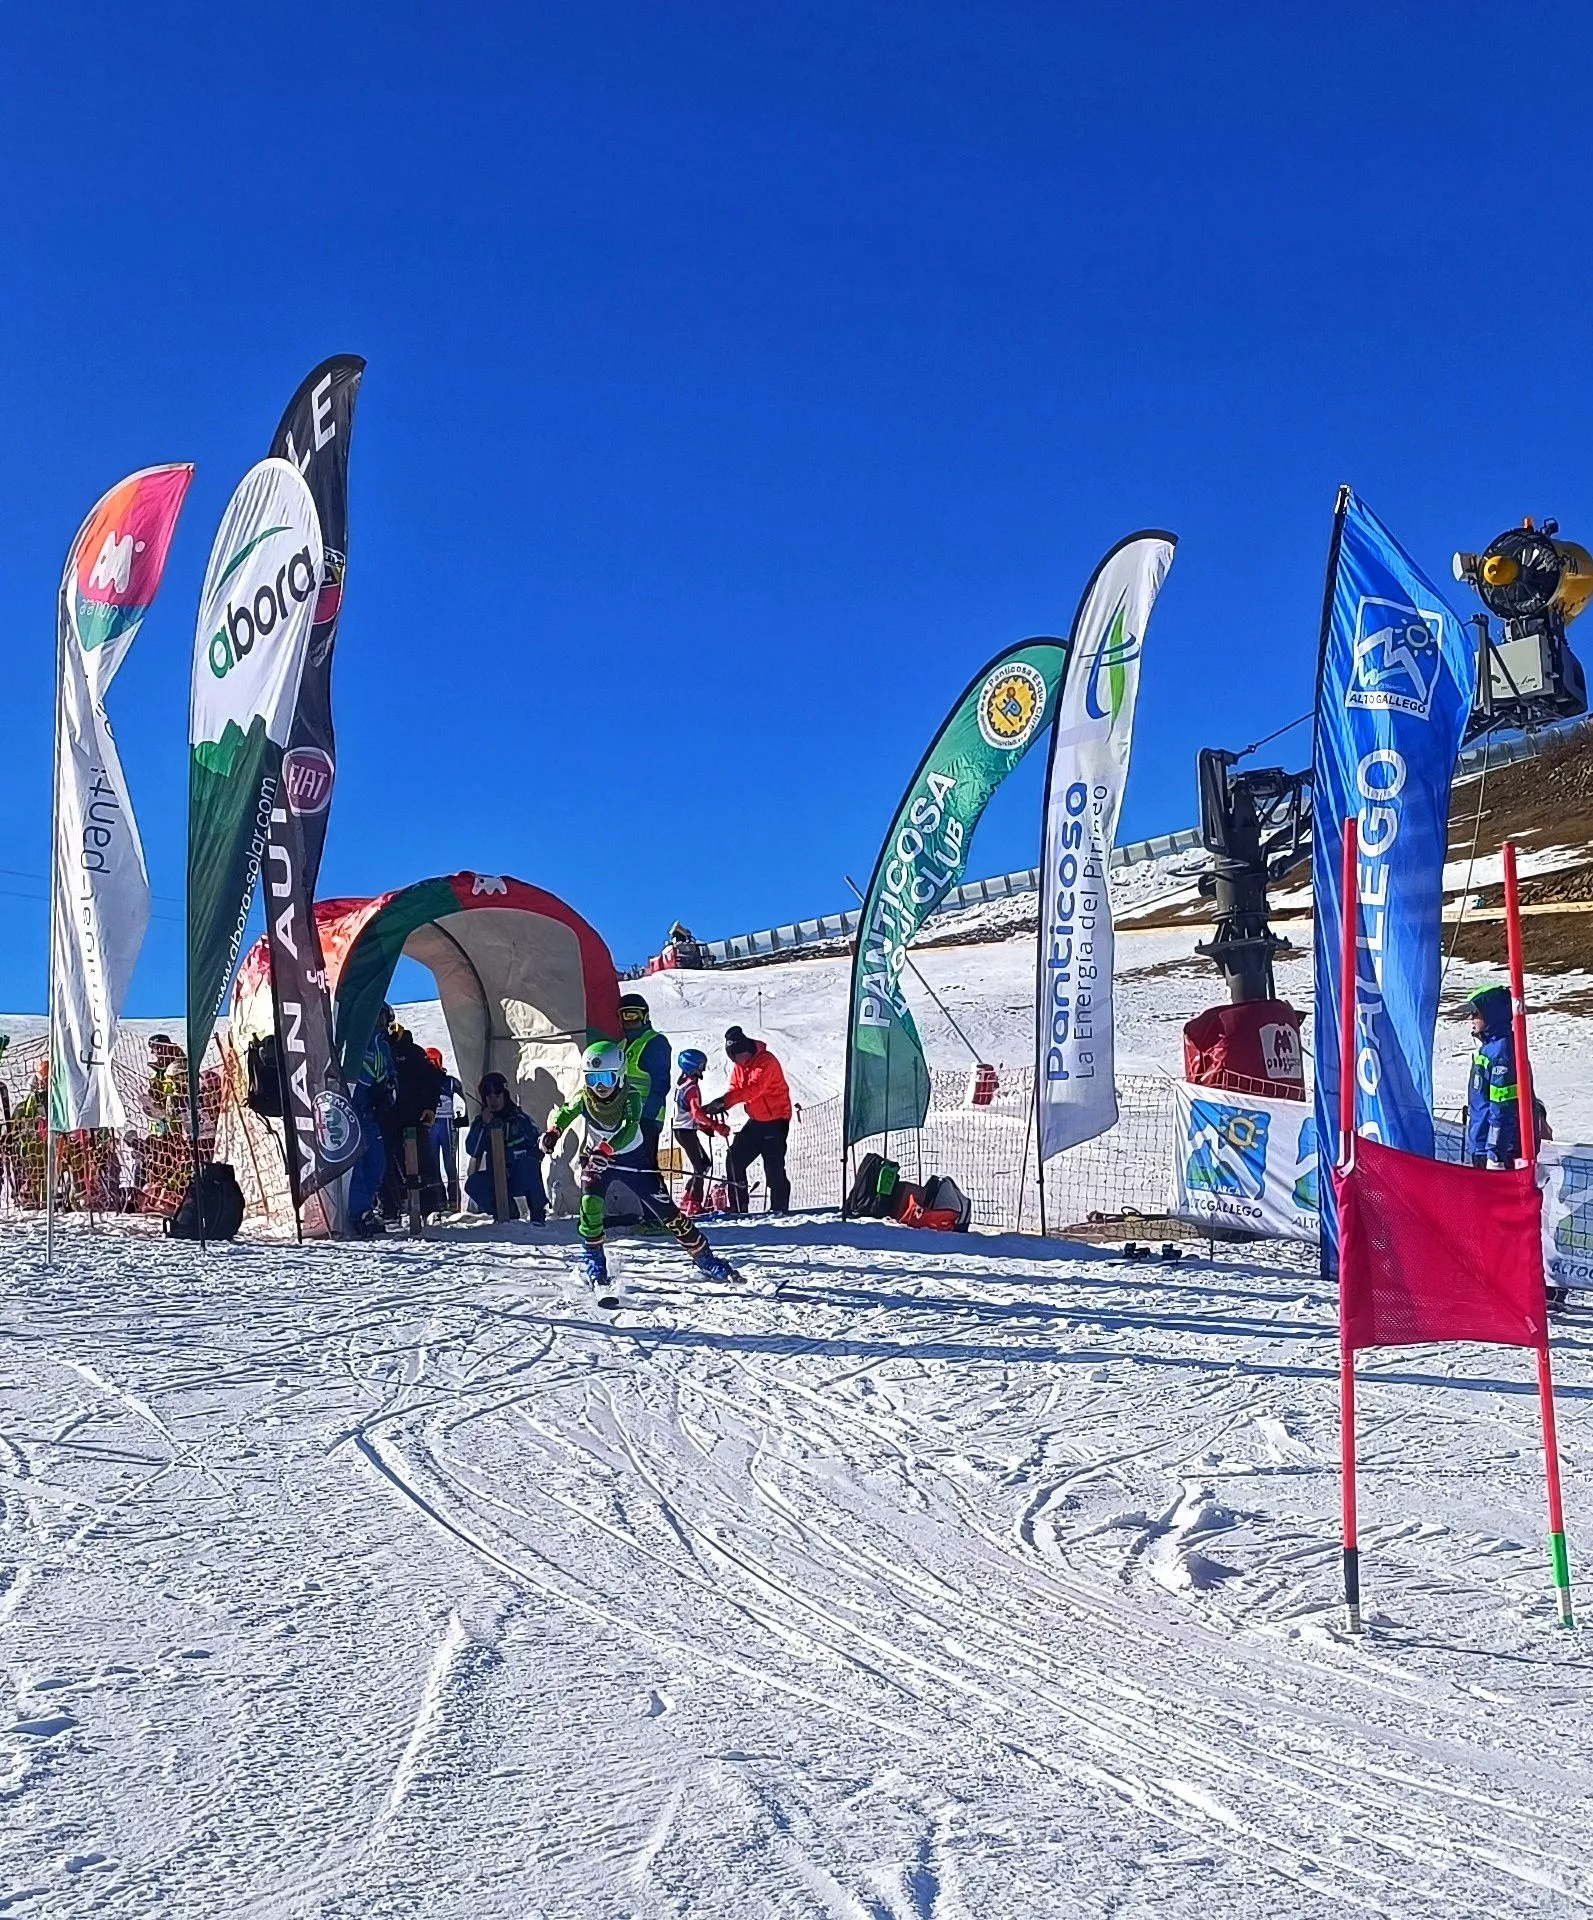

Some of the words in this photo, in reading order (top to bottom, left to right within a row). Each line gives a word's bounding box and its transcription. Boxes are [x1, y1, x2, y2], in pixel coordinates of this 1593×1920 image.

[208, 544, 316, 679] abora
[988, 664, 1033, 688] Panticosa
[287, 762, 329, 802] FIAT
[858, 770, 958, 1028] PANTICOSA
[910, 815, 965, 905] CLUB
[1046, 781, 1089, 1082] Panticosa
[1078, 890, 1100, 930] del
[1073, 941, 1099, 1041] Energía
[282, 1001, 316, 1184] VIAN
[1075, 1051, 1095, 1080] La
